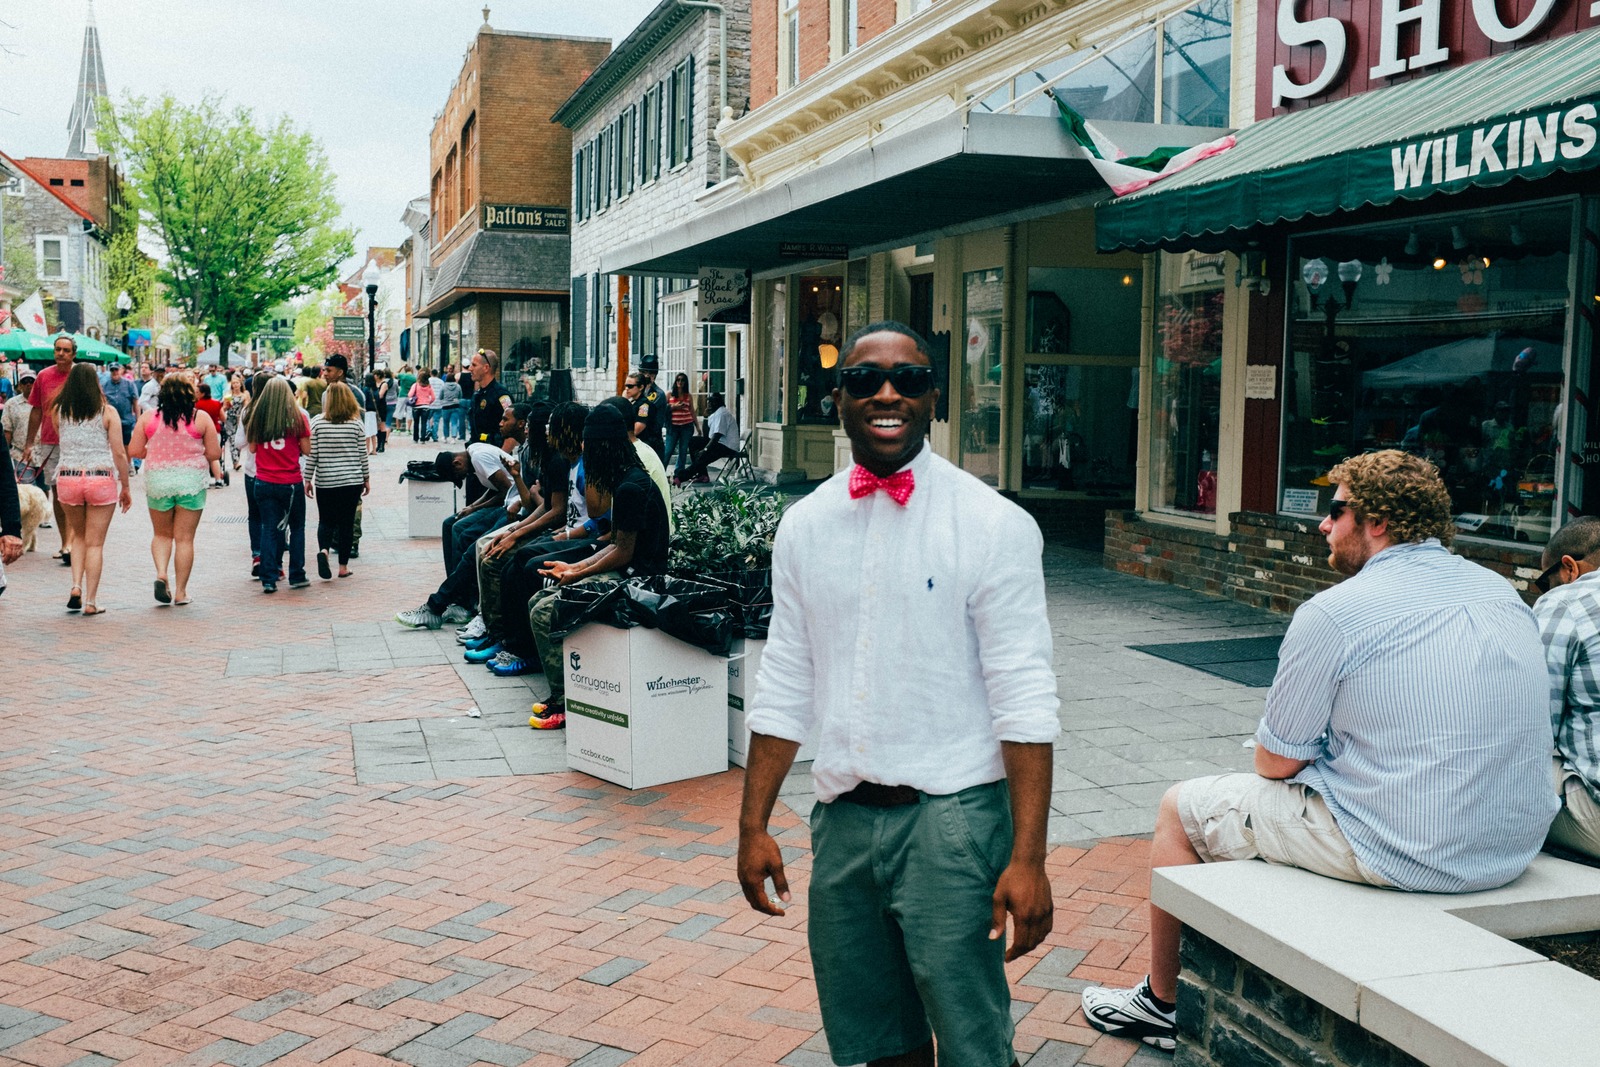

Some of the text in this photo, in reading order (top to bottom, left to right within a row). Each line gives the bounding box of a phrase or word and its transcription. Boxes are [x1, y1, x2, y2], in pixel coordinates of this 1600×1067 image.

[1391, 104, 1598, 191] WILKINS
[485, 206, 542, 228] Patton's
[545, 219, 566, 227] SALES
[710, 269, 725, 279] The
[700, 277, 734, 291] Black
[704, 290, 734, 304] Rose
[1583, 441, 1600, 449] WIL
[570, 673, 621, 693] corrugated
[646, 676, 701, 691] Winchester
[570, 703, 625, 723] where creativity unfolds
[580, 748, 615, 764] cccbox.com
